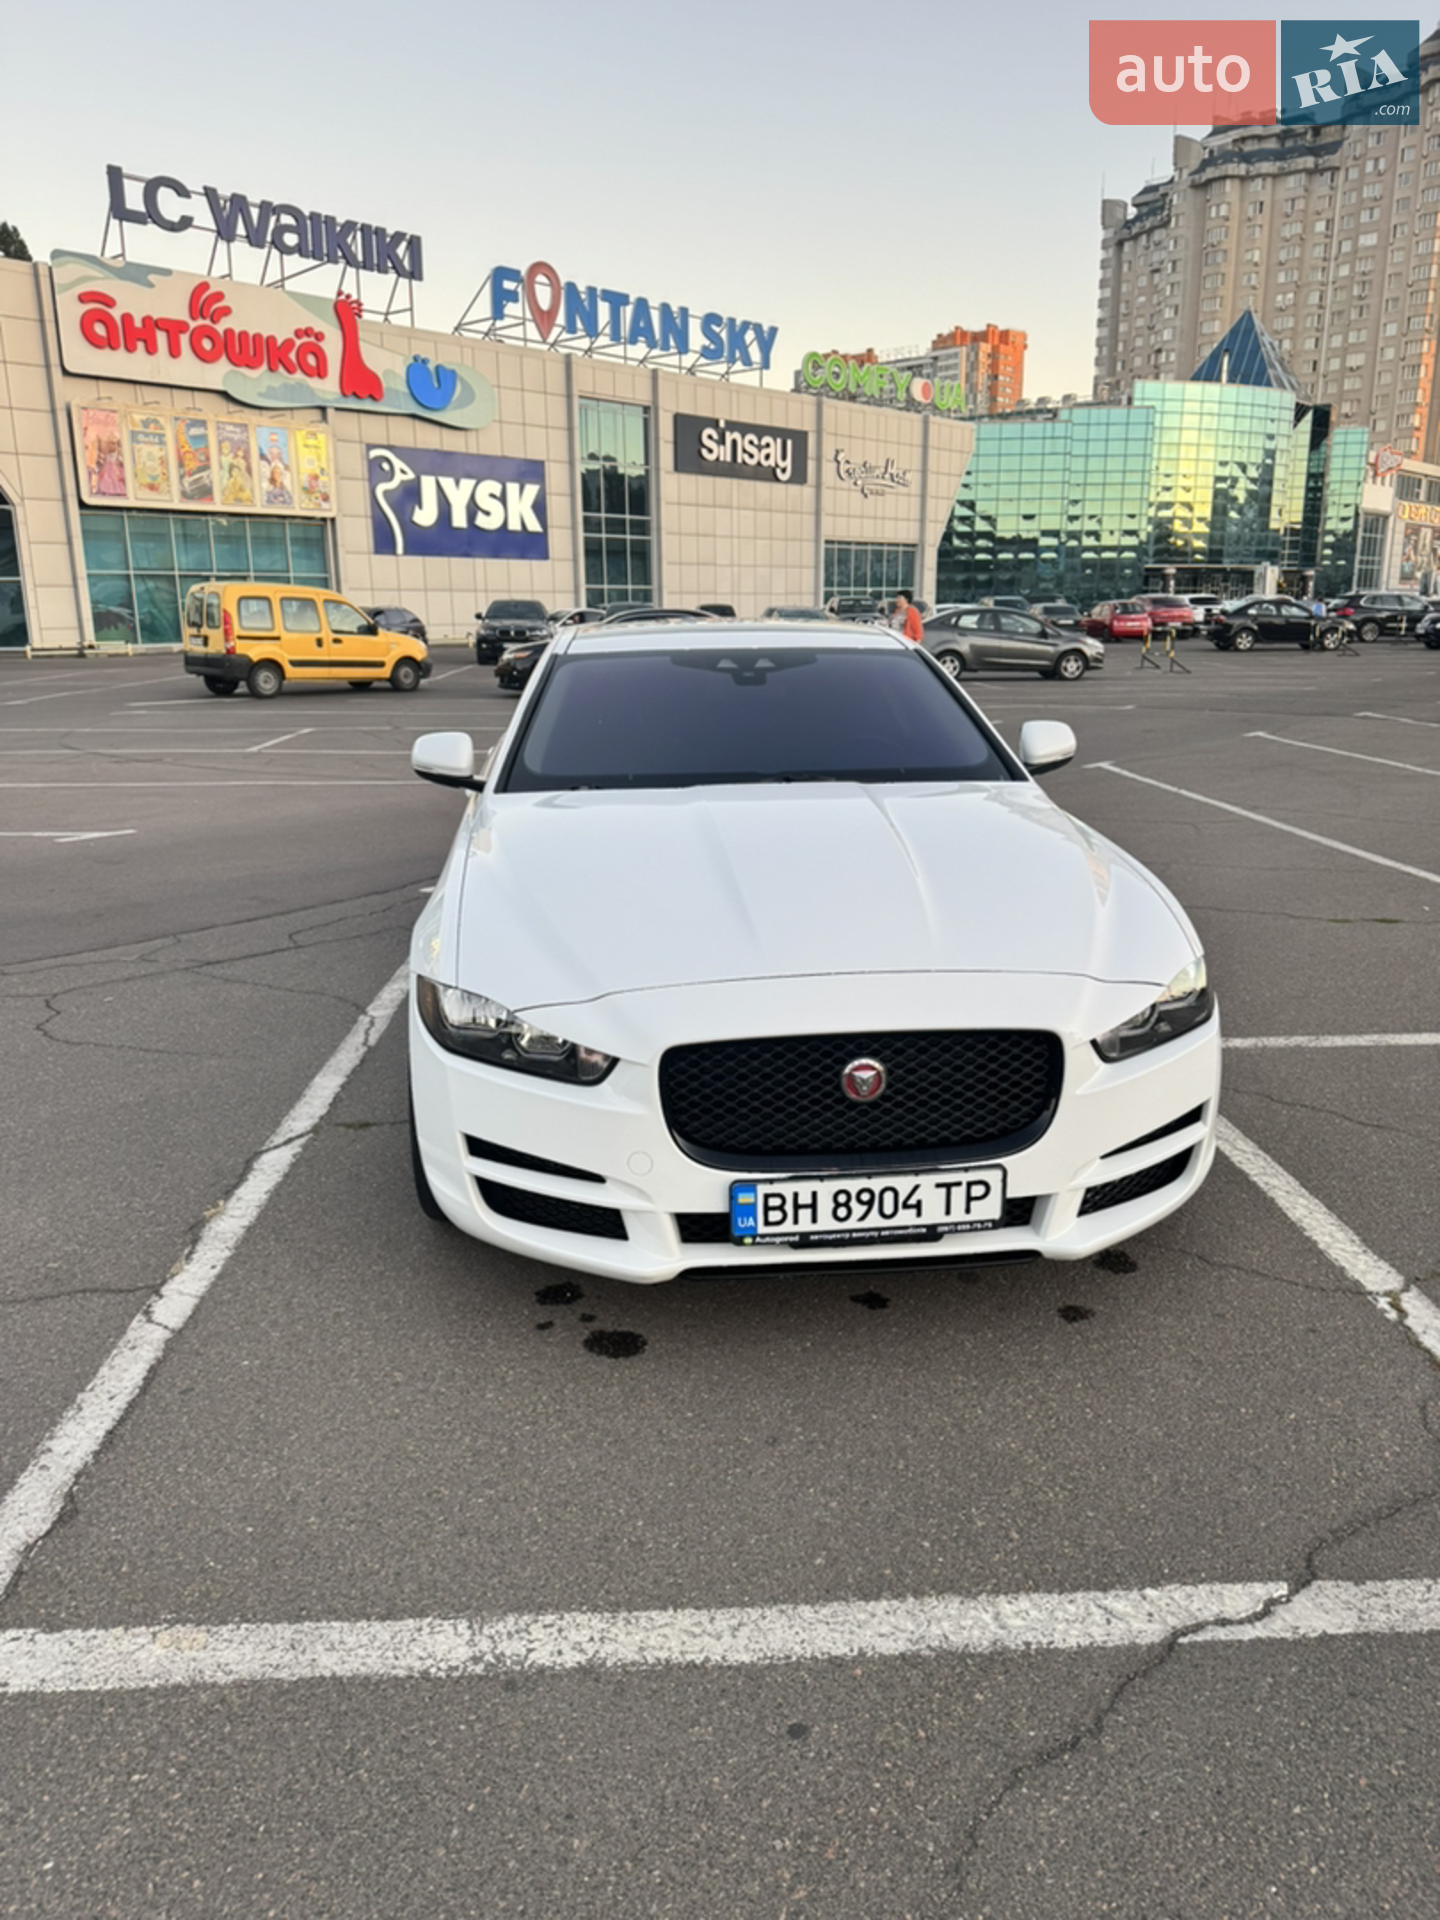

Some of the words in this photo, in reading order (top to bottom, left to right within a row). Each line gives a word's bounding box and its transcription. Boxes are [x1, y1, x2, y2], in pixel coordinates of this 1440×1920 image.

[106, 163, 194, 233] LC
[490, 260, 689, 355] FONTAN
[700, 312, 779, 371] SKY
[699, 418, 793, 482] sinsay
[411, 474, 544, 533] JYSK
[738, 1215, 756, 1228] UA
[762, 1190, 818, 1227] BH
[831, 1183, 923, 1223] 8904
[935, 1179, 992, 1216] TP
